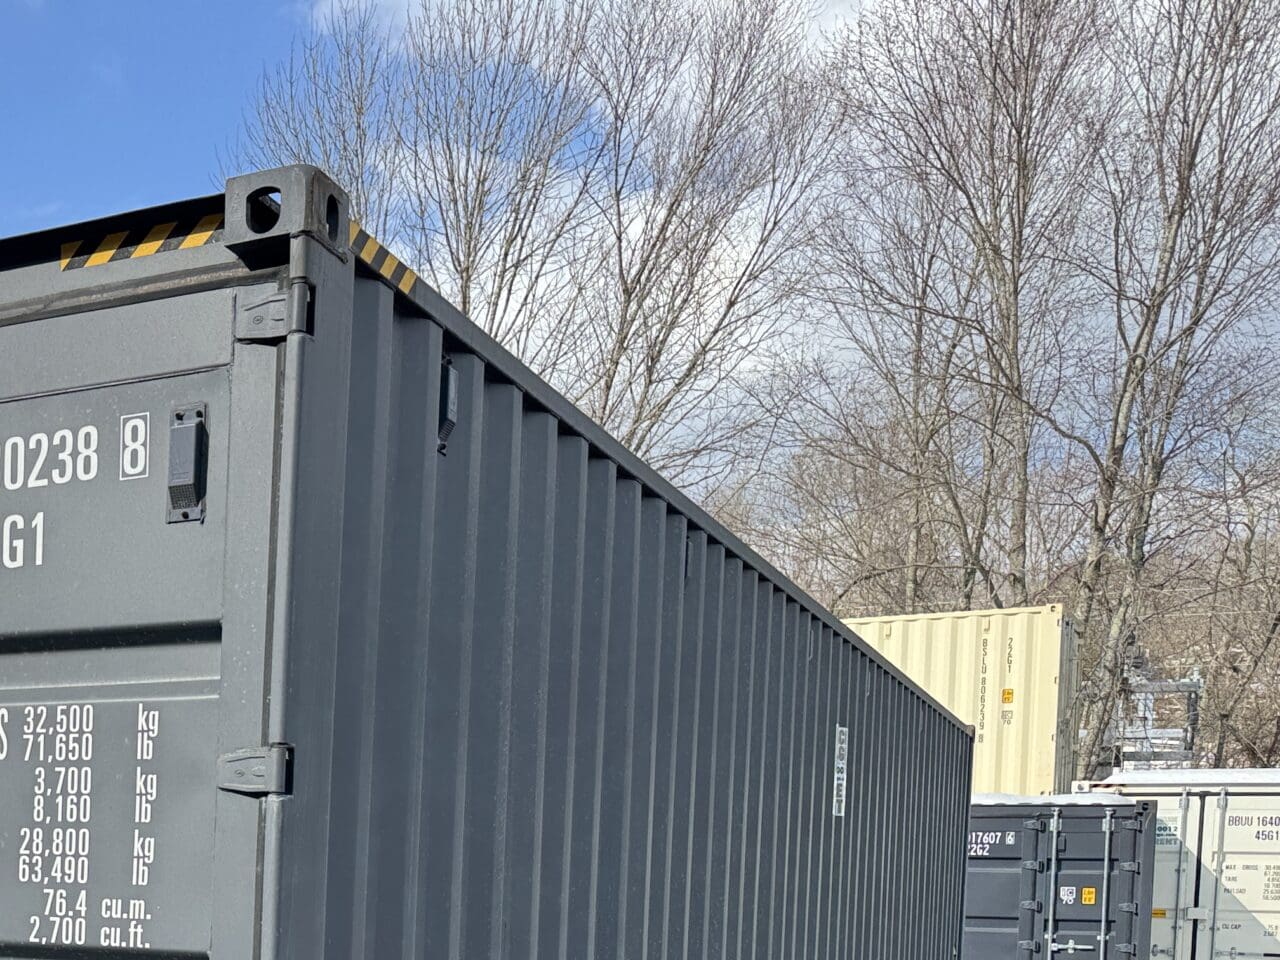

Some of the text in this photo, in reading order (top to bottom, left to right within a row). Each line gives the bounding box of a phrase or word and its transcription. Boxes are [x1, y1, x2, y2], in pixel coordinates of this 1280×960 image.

[122, 416, 148, 477] 8
[23, 703, 159, 737] 32,500 kg
[23, 733, 153, 763] 71,650 lb
[34, 766, 157, 800] 3,700 kg
[33, 795, 151, 824] 8,160 lb
[1228, 815, 1253, 827] BBUU
[19, 827, 155, 863] 28,800 kg
[969, 831, 1002, 844] 17607
[1255, 830, 1279, 841] 45G1
[18, 856, 148, 886] 63,490 lb
[43, 888, 152, 920] 76.4 cu.m.
[29, 916, 150, 948] 2,700 cu.ft.
